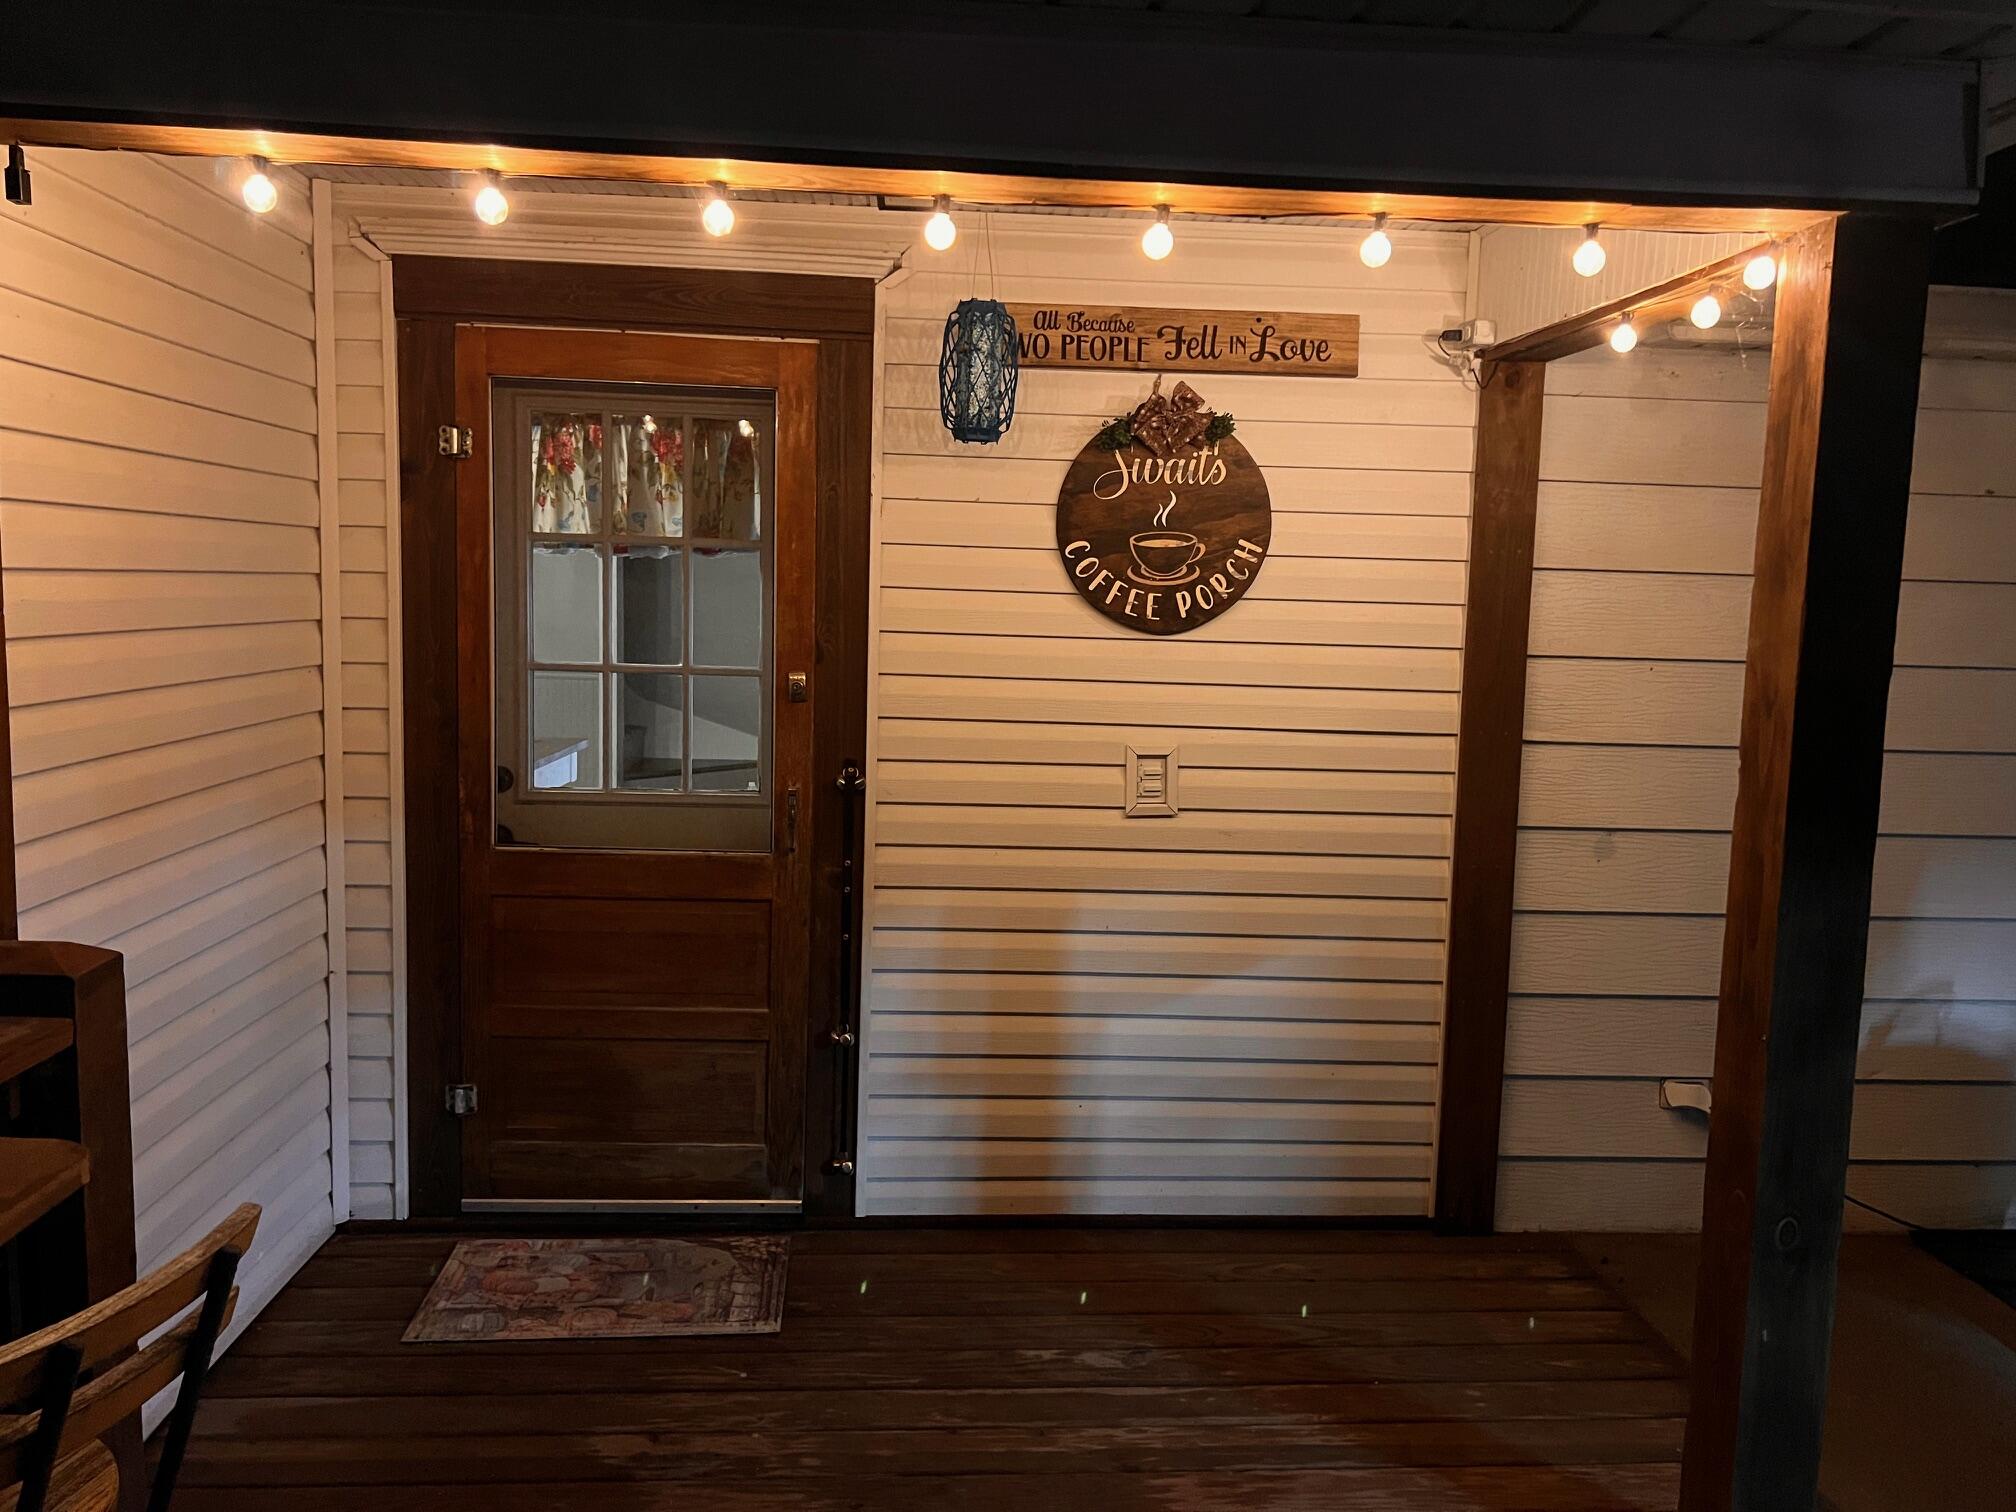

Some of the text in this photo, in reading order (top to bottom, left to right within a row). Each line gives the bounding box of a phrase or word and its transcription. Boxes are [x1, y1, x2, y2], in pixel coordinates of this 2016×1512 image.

[1017, 317, 1332, 363] WO PEOPLE Fell IN Love
[1033, 310, 1136, 333] All Because
[1064, 538, 1264, 621] COFFEE PORCH
